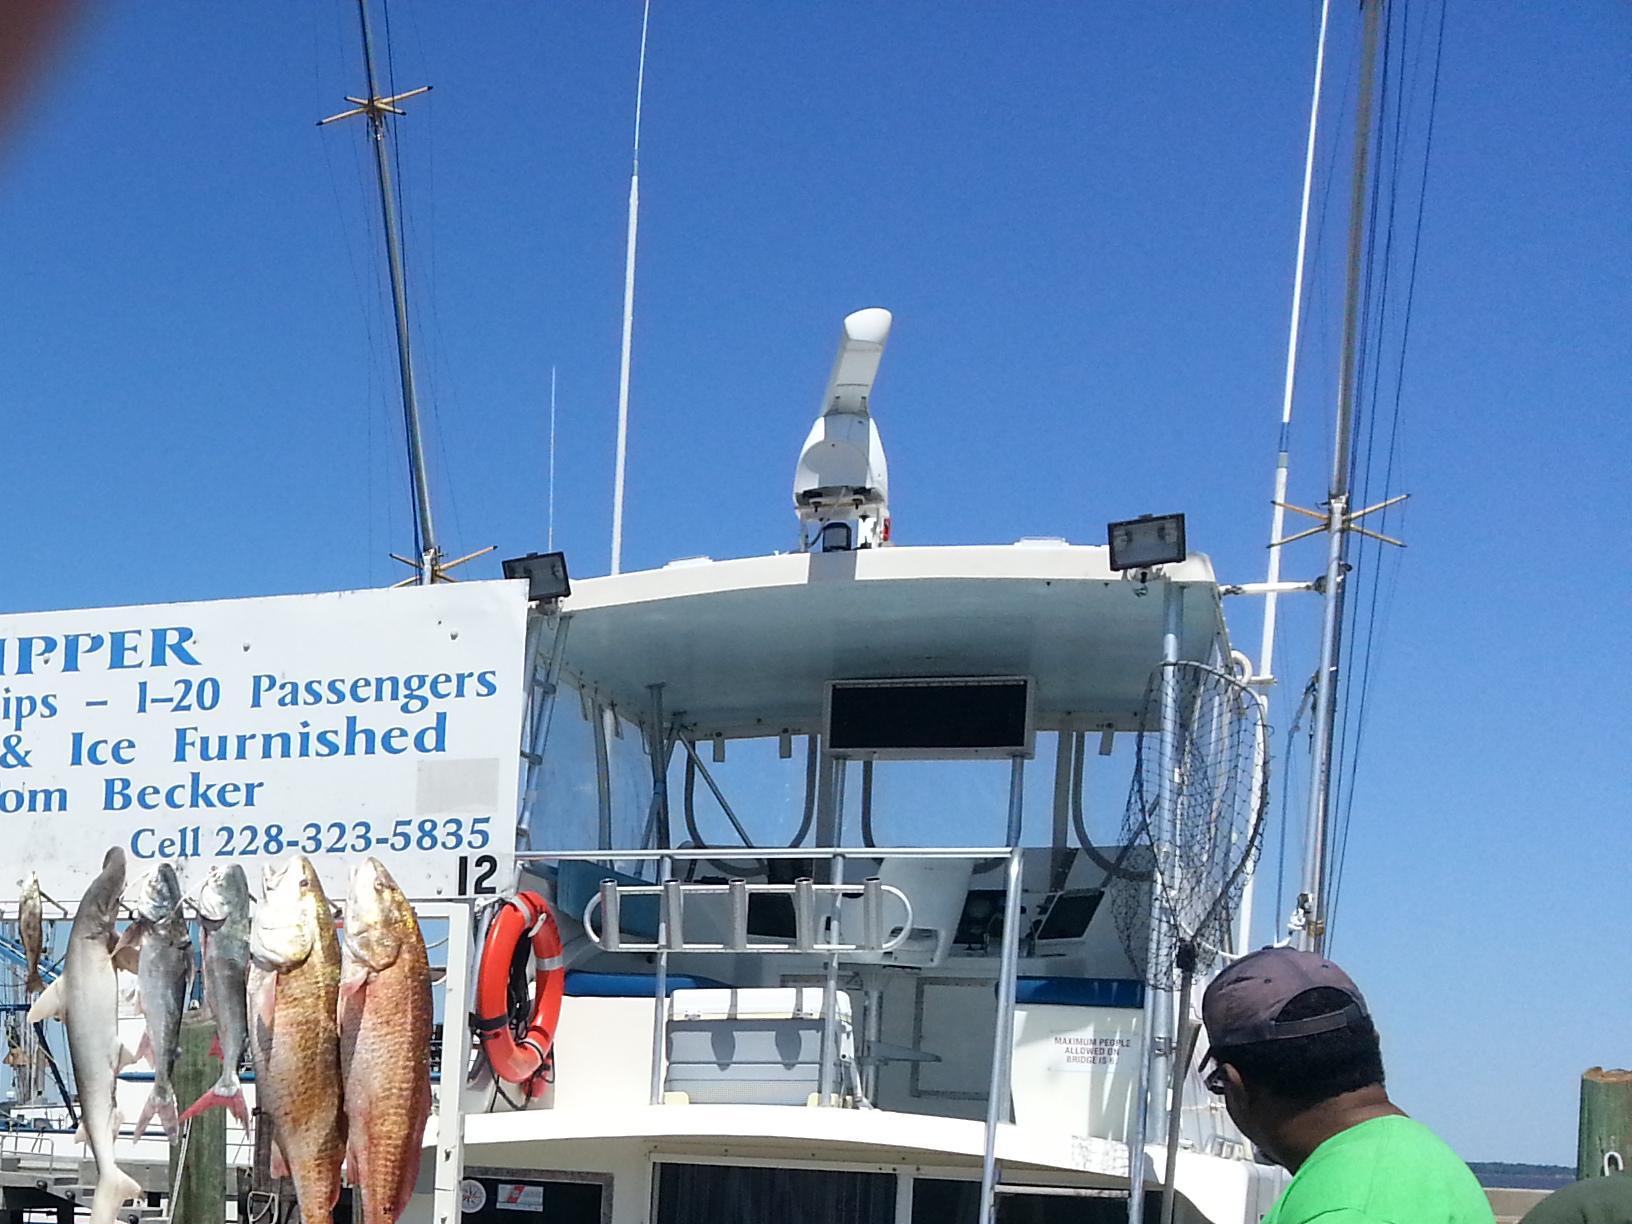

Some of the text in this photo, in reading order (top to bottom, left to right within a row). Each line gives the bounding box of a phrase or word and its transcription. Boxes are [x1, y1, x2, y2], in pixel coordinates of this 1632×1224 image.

[137, 676, 220, 713] 1-20
[250, 670, 497, 714] Passengers
[70, 732, 136, 767] Ice
[173, 712, 447, 763] Furnished
[103, 771, 264, 811] Becker
[130, 825, 200, 860] Cell
[215, 816, 491, 857] 228-323-5835
[458, 855, 497, 895] 12
[1054, 1036, 1131, 1048] MAXIMUM PEOPLE
[1065, 1047, 1105, 1056] ALLOWED
